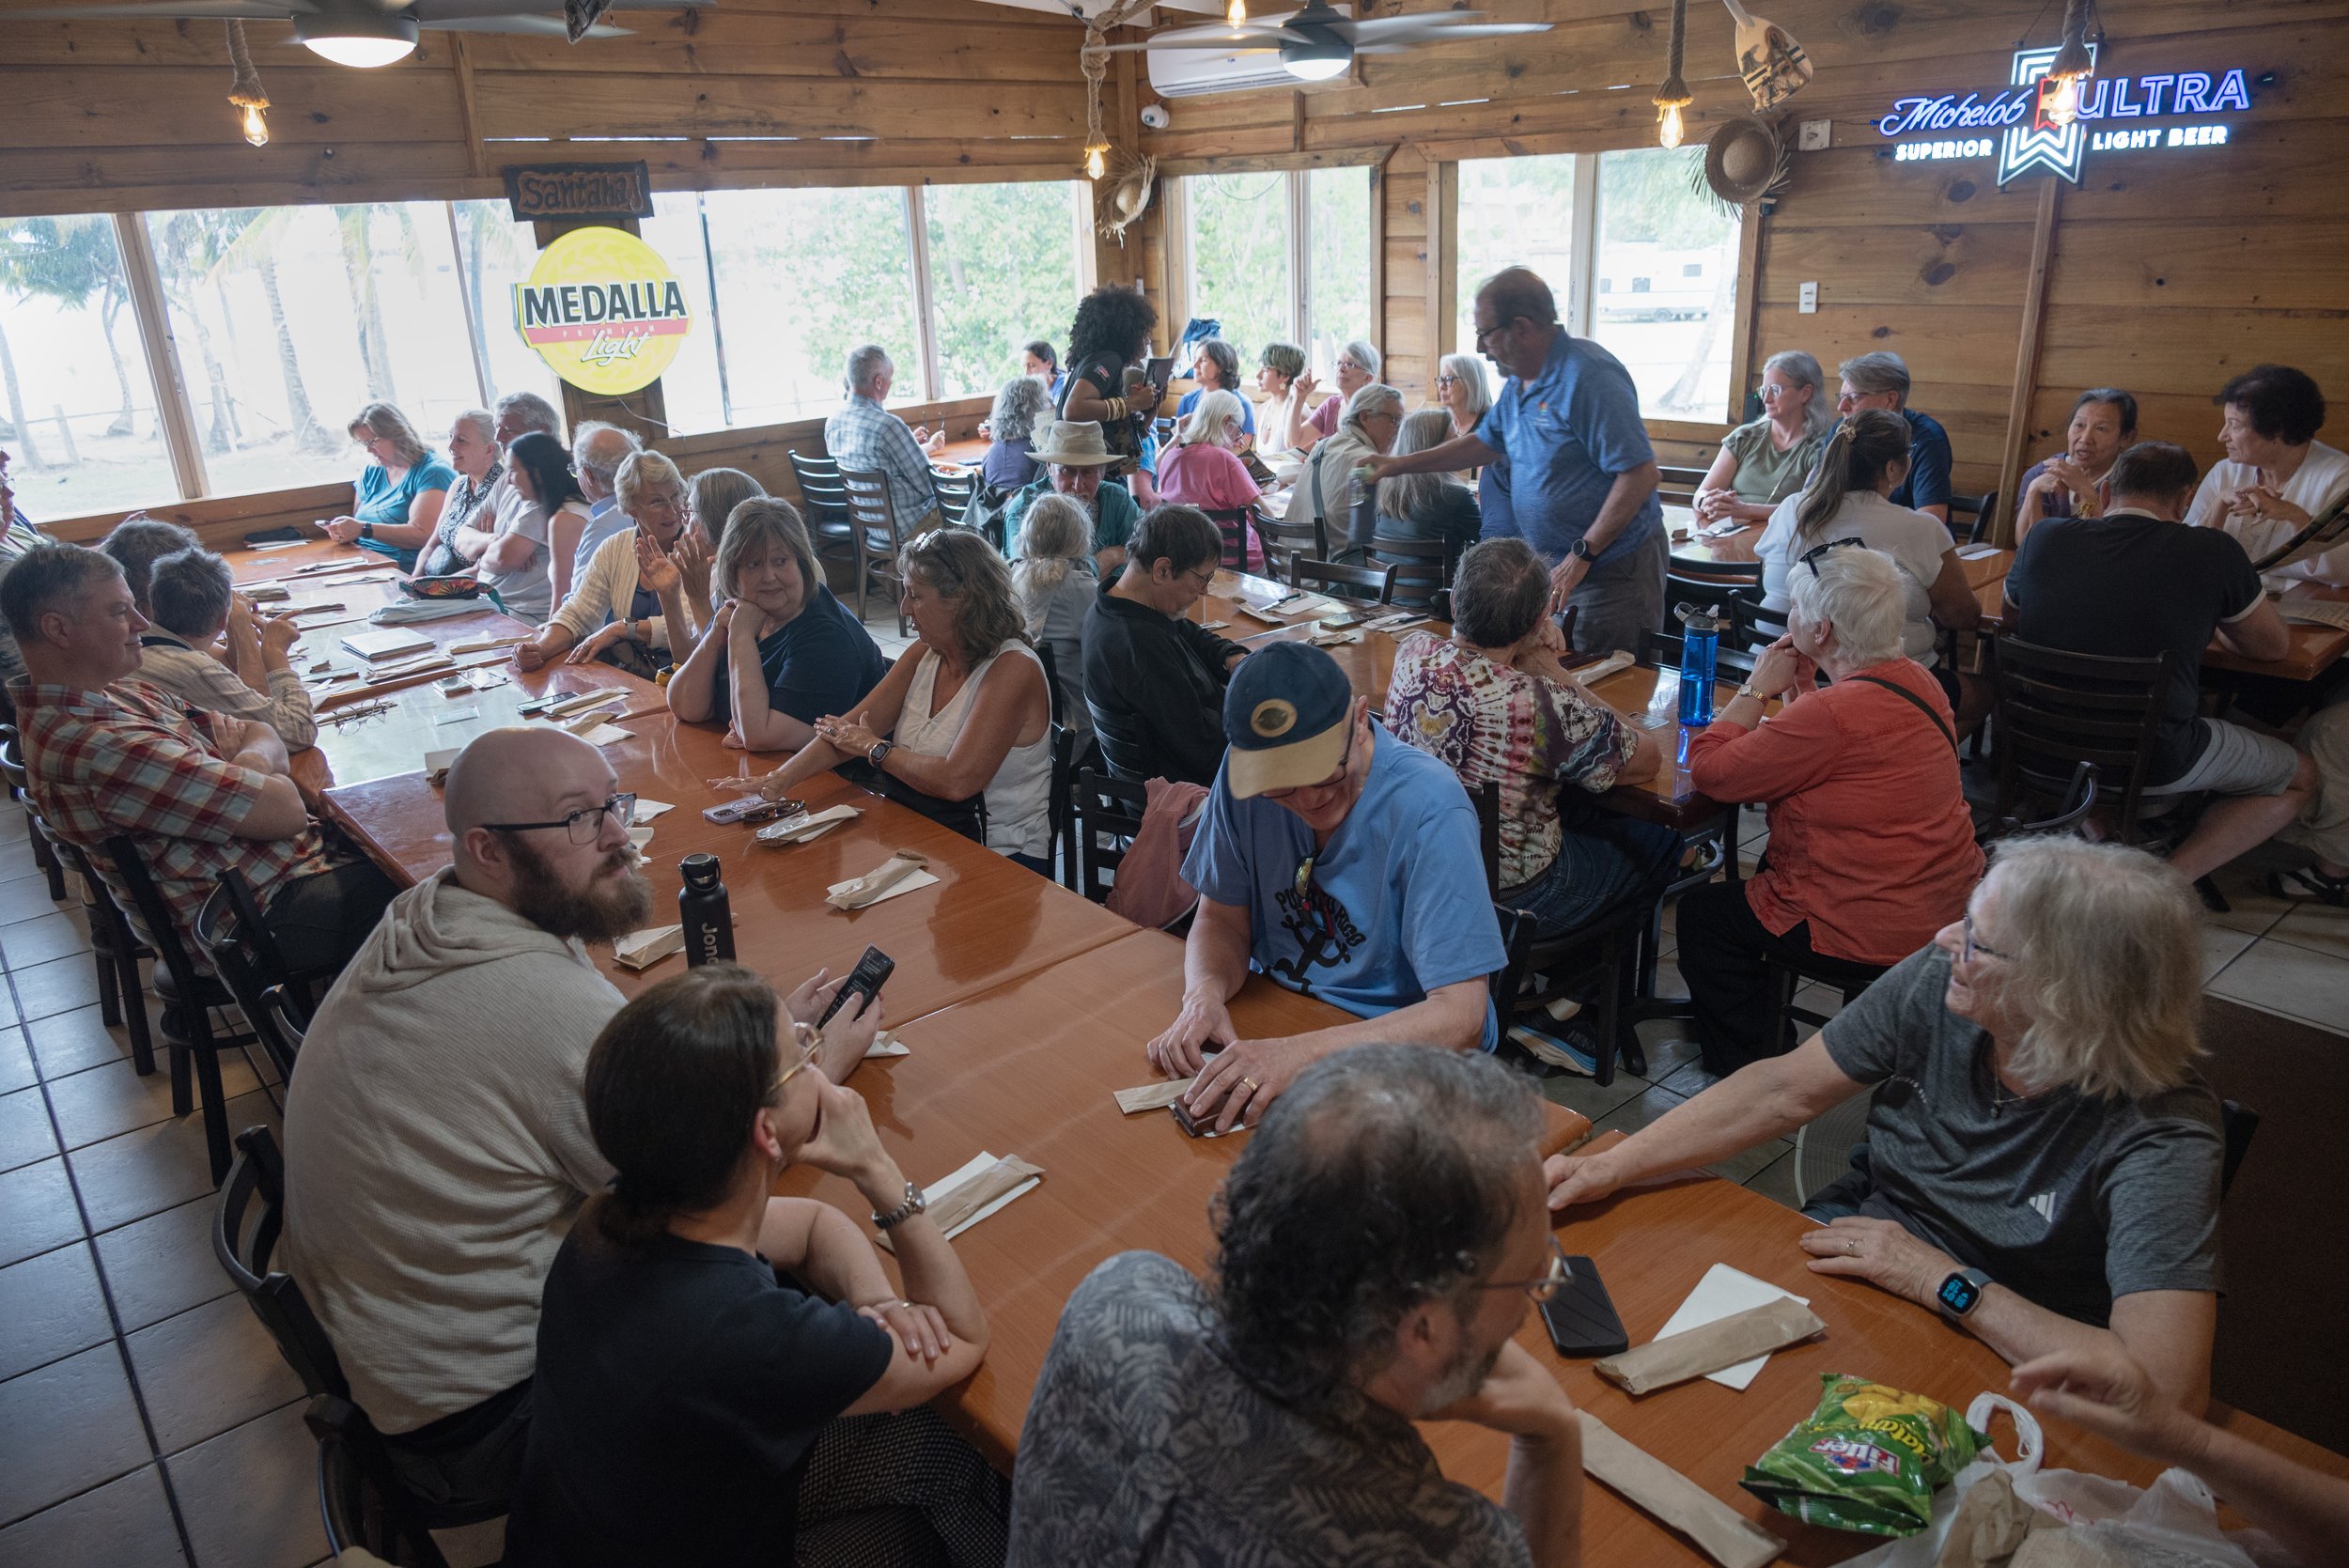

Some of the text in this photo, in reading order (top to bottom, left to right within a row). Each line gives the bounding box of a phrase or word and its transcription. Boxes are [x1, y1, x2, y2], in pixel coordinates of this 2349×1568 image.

[1879, 70, 2249, 135] Michelob ULTRA
[1895, 126, 2228, 161] SUPERIOR LIGHT BEER
[523, 282, 687, 324] MEDALLA
[581, 331, 650, 365] Light
